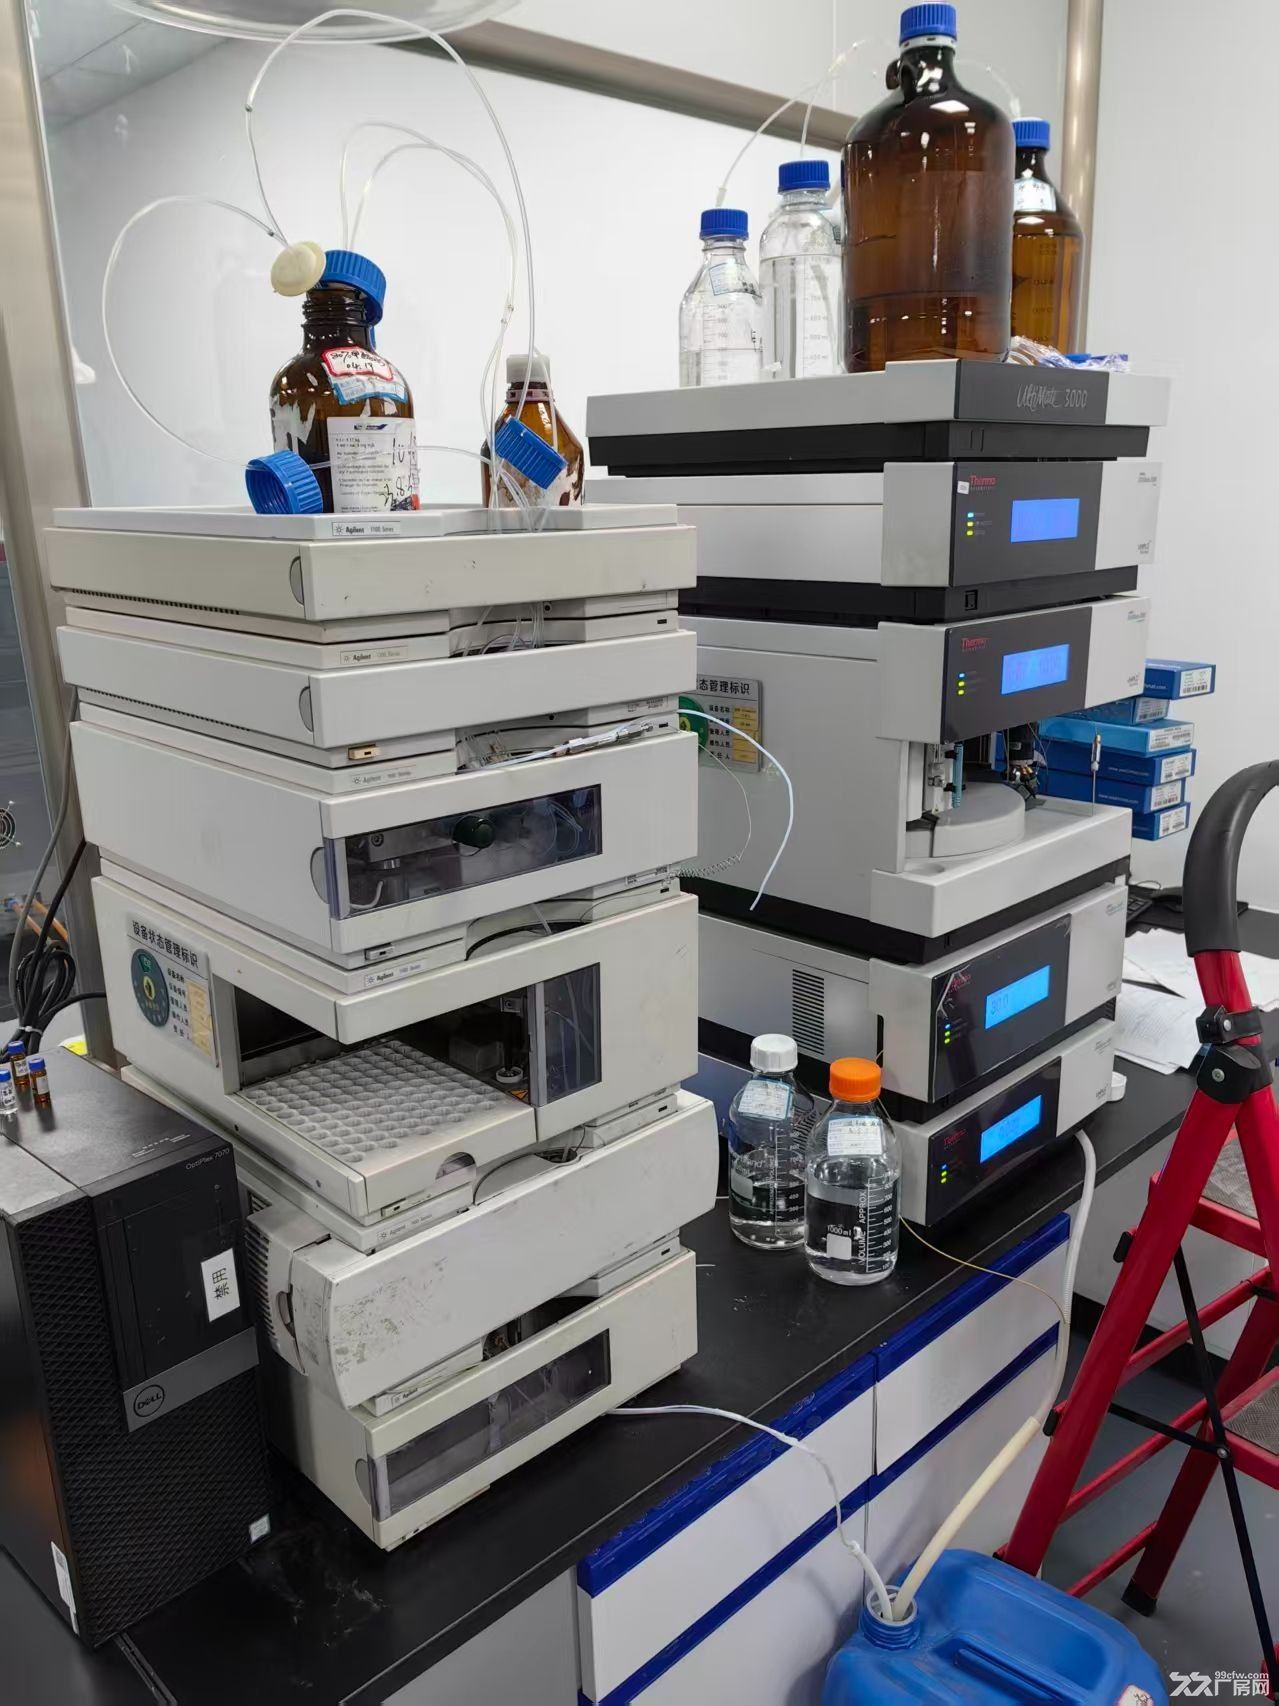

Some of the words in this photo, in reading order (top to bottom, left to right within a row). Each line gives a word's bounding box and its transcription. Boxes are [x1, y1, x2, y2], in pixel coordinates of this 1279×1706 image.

[1064, 388, 1088, 408] 3000
[346, 526, 365, 535] Agilent
[353, 654, 371, 662] Agilent
[697, 679, 750, 695] 态管理标识
[132, 920, 199, 969] 设备状态管理标识
[214, 1148, 230, 1159] 7070
[827, 1225, 843, 1235] 1000
[858, 1231, 866, 1266] VOLUME
[212, 1267, 230, 1300] 禁用
